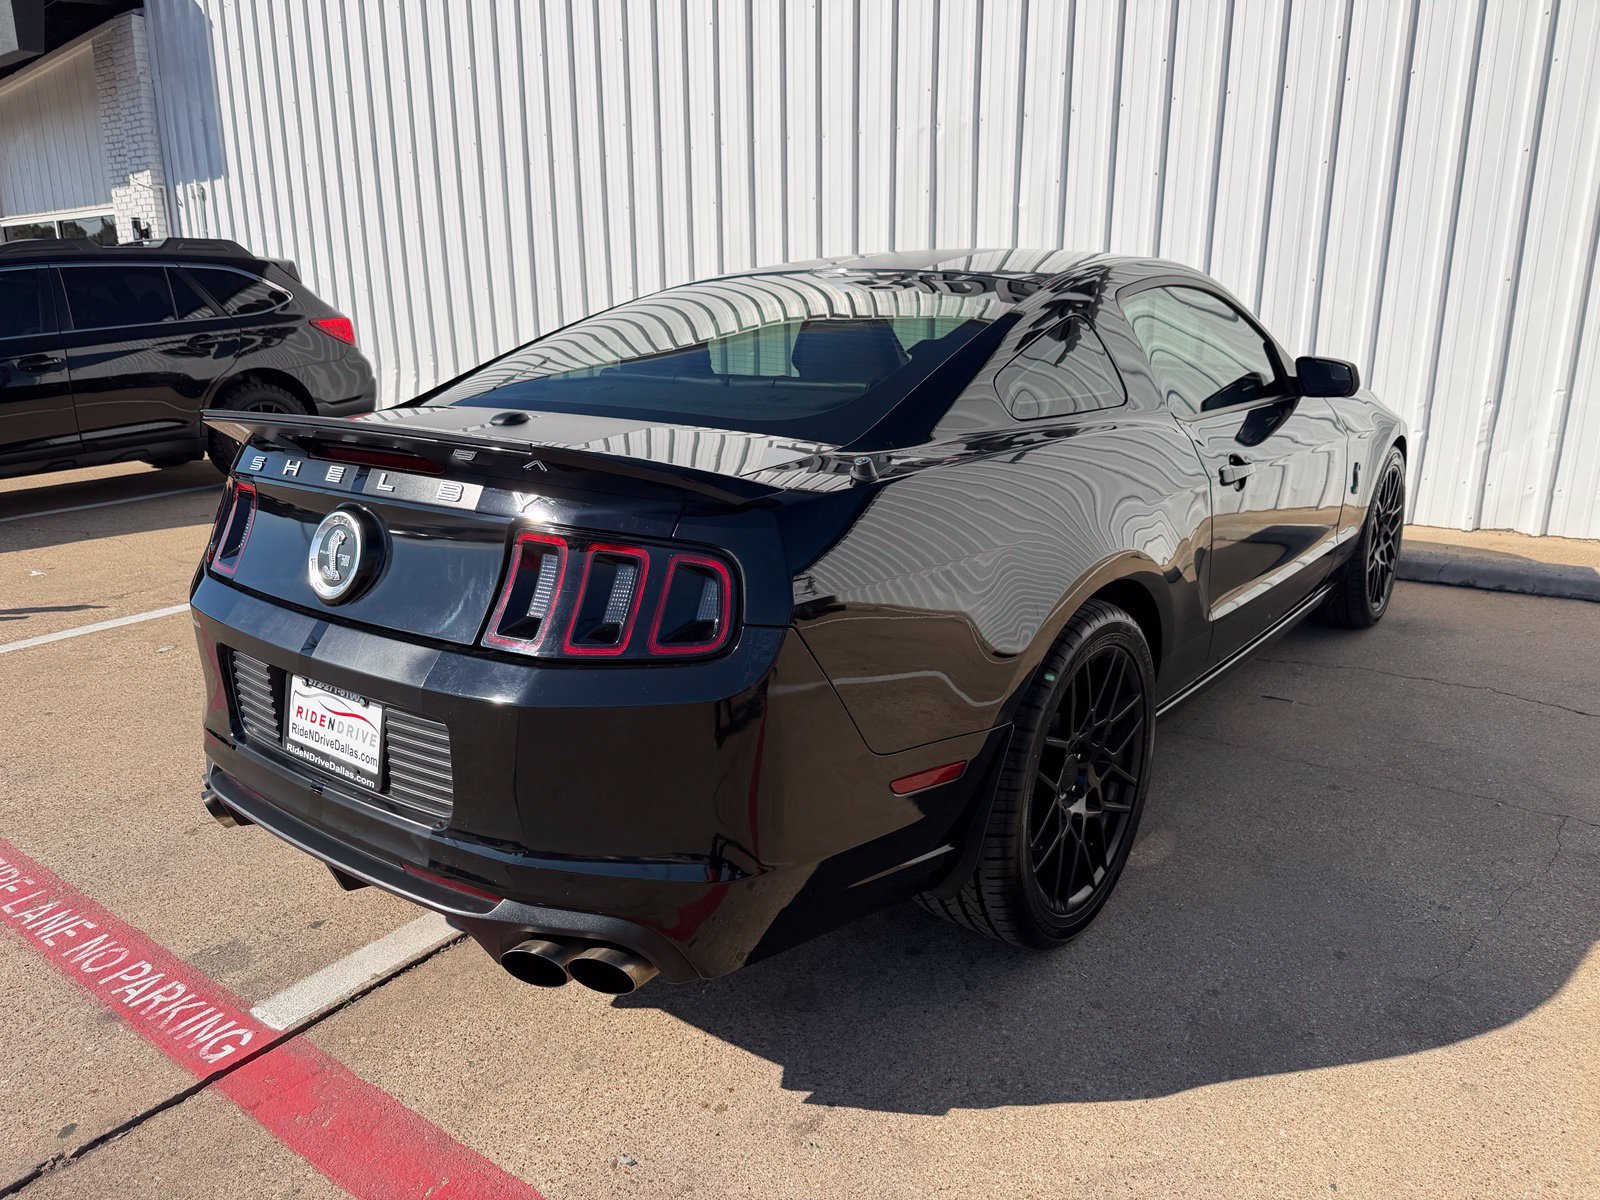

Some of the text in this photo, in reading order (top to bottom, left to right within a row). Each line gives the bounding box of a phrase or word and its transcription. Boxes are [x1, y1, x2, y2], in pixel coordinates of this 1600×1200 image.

[249, 455, 542, 513] SHELBY
[286, 742, 375, 788] RideNDriveDallas.com
[291, 722, 378, 768] RideNDriveDallas.com
[1, 889, 97, 947] LANE
[63, 933, 130, 973] NO
[98, 960, 253, 1064] PARKING
